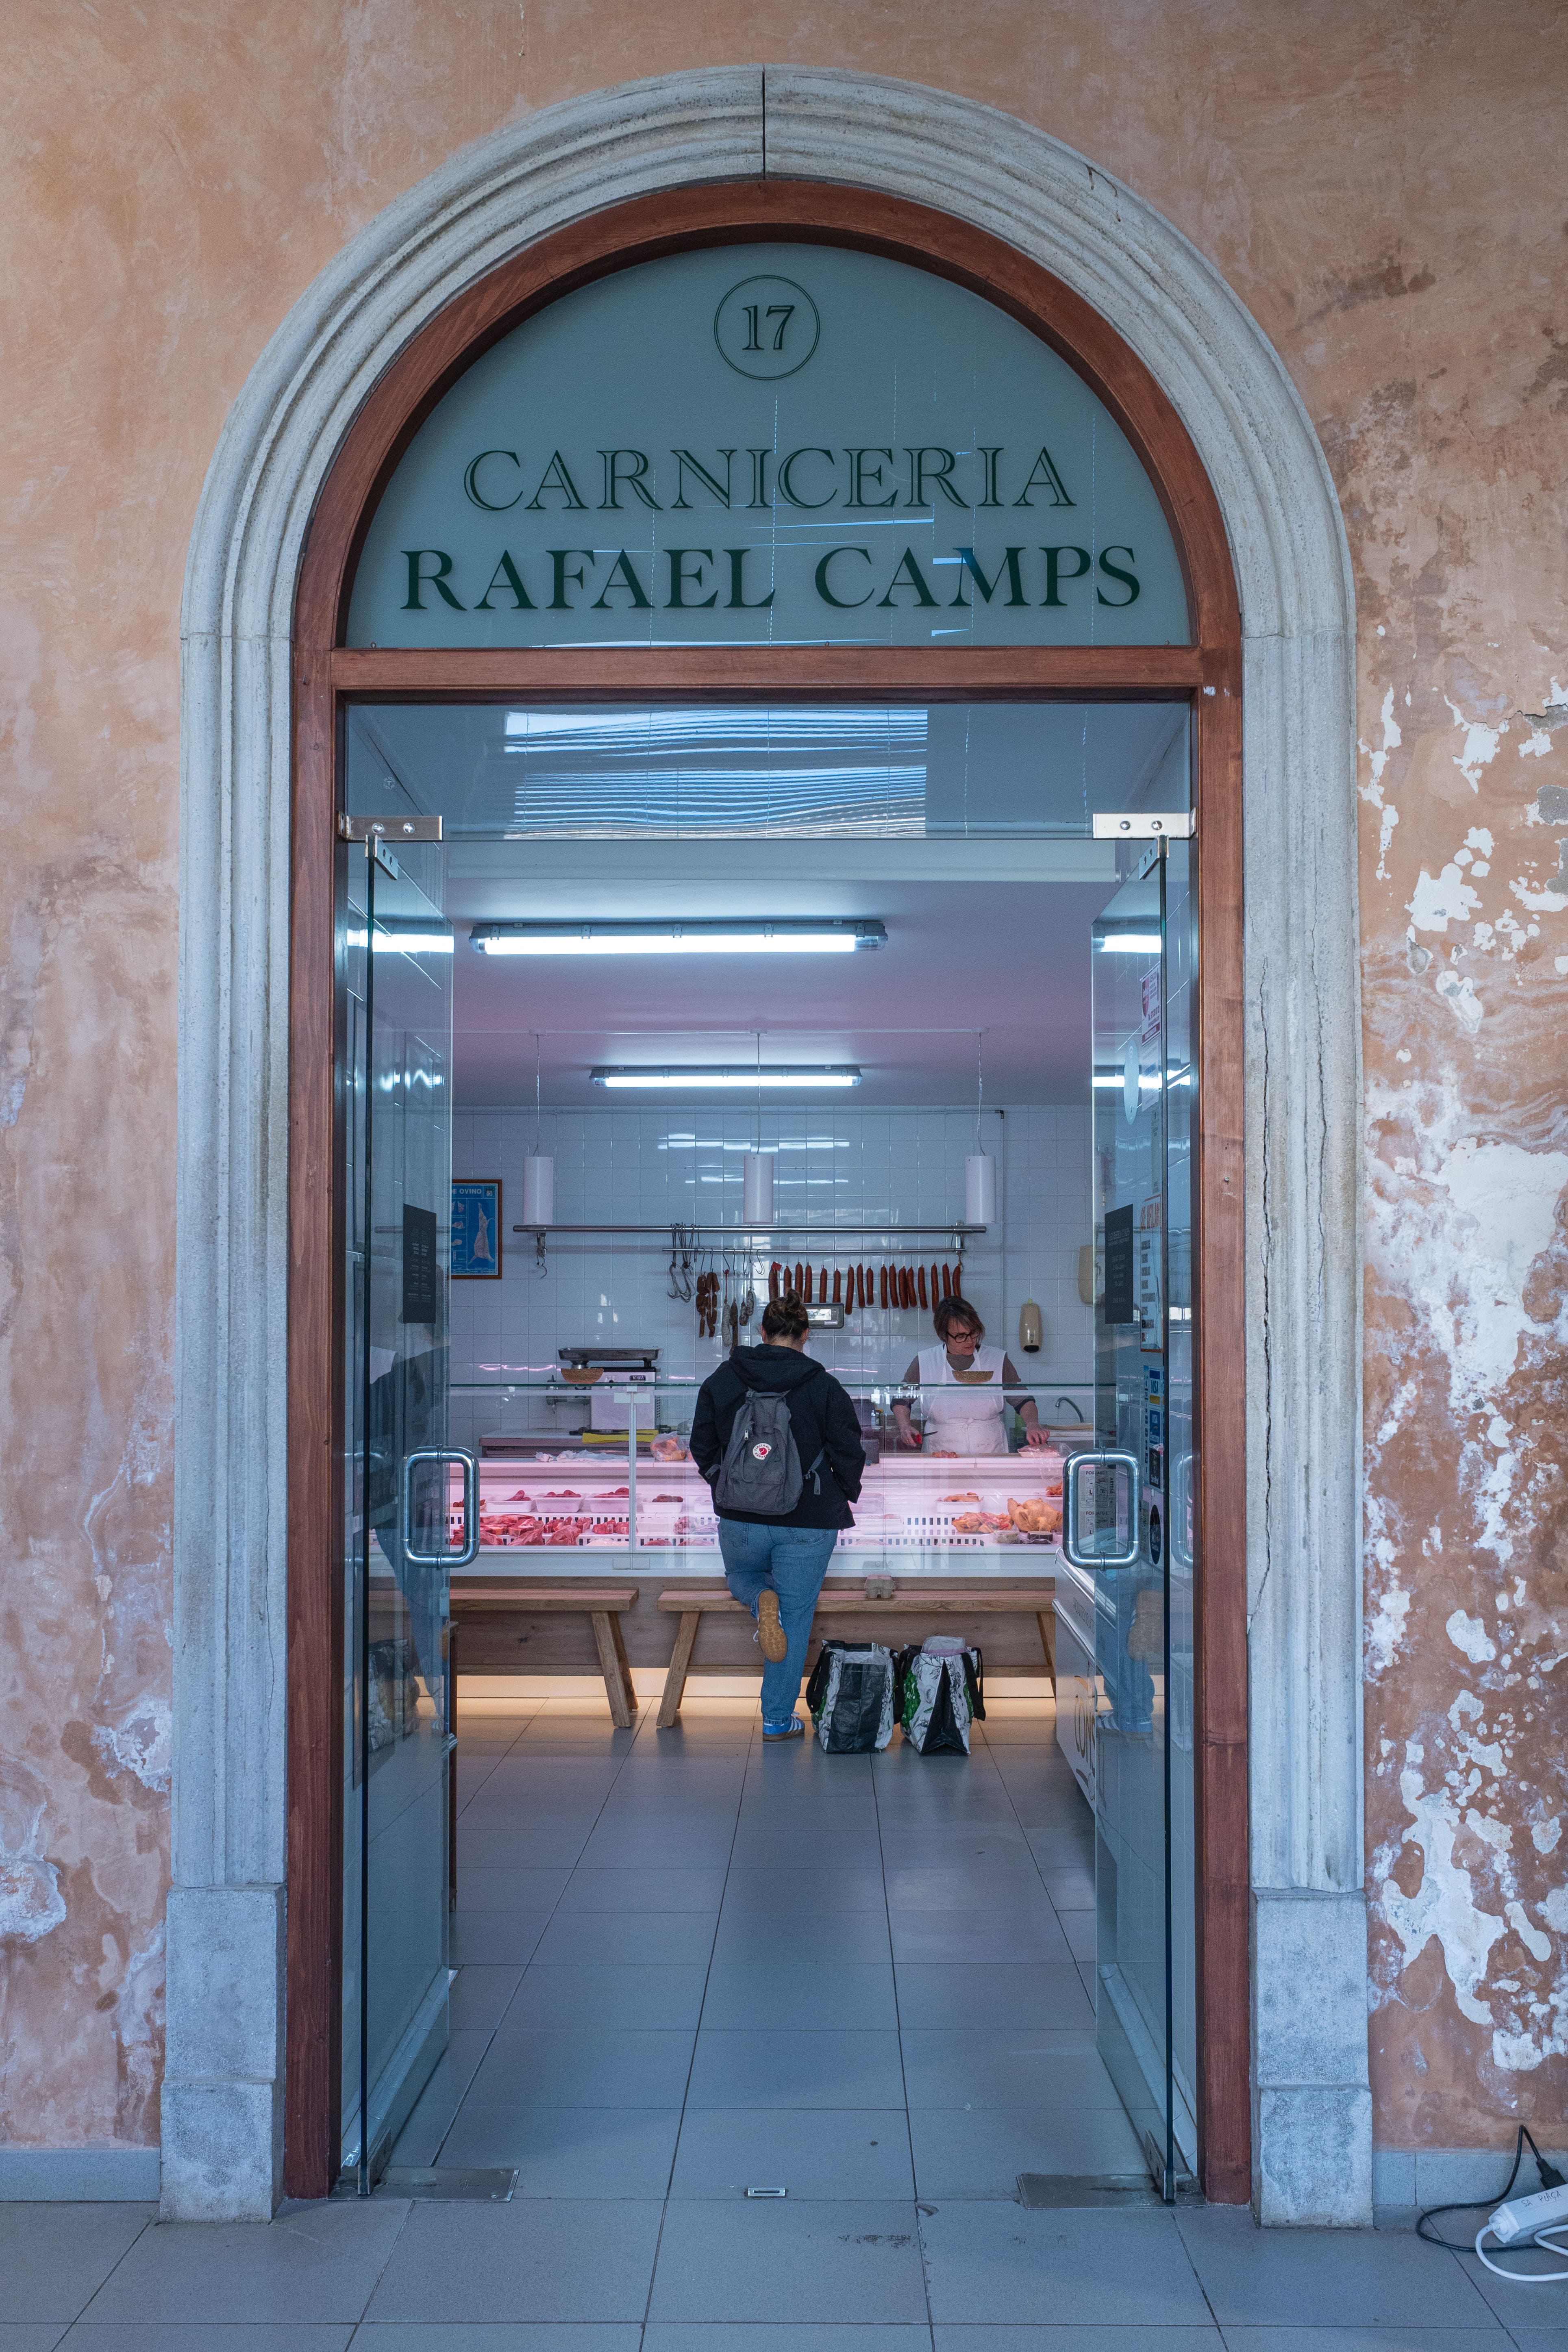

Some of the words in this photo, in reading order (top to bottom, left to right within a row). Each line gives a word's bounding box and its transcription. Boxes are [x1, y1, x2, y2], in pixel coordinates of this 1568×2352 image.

[742, 304, 794, 351] 17
[464, 446, 1077, 511] CARNICERIA
[400, 548, 776, 611] RAFAEL
[815, 546, 1141, 608] CAMPS
